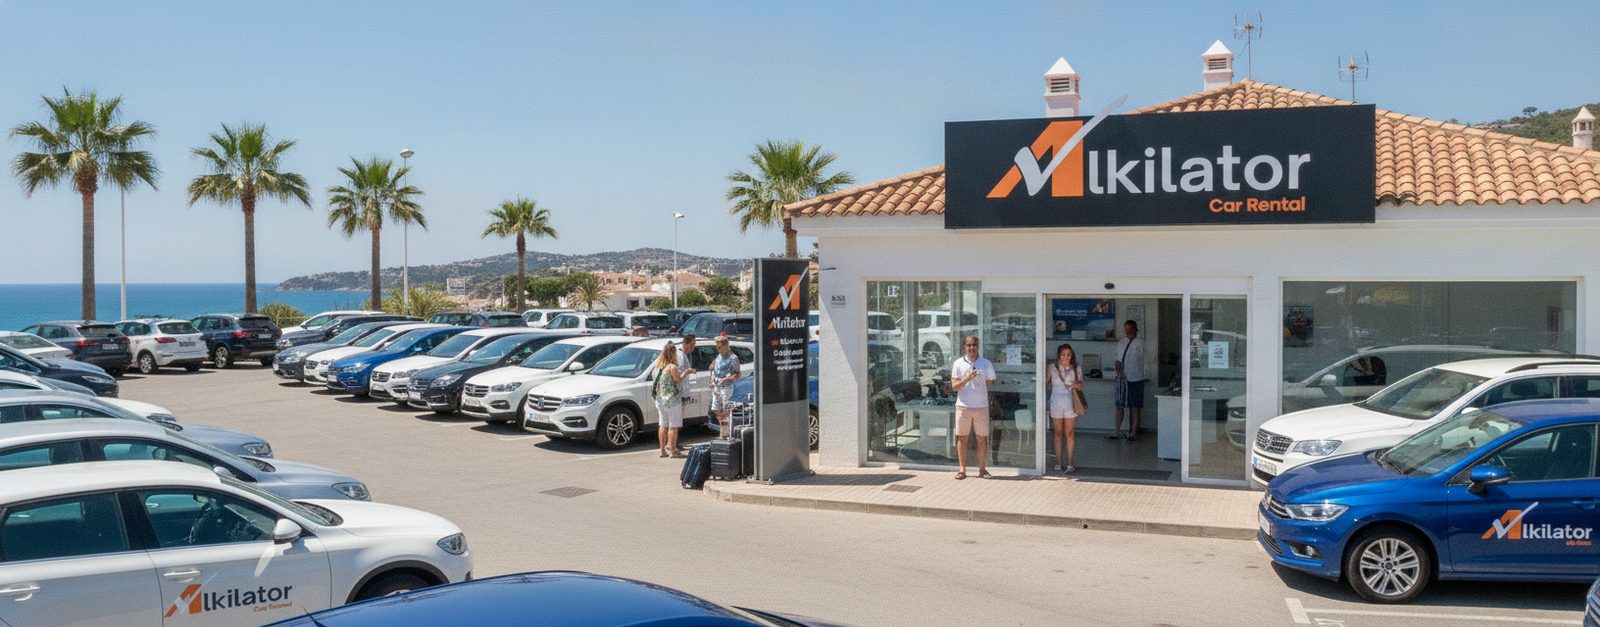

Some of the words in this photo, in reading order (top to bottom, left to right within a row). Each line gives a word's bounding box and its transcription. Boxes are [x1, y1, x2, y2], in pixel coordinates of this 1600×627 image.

[986, 96, 1311, 198] Alkilator
[1209, 198, 1243, 212] Car
[1246, 196, 1306, 212] Rental
[1481, 501, 1593, 540] Alkilator
[164, 574, 293, 618] Alkilator
